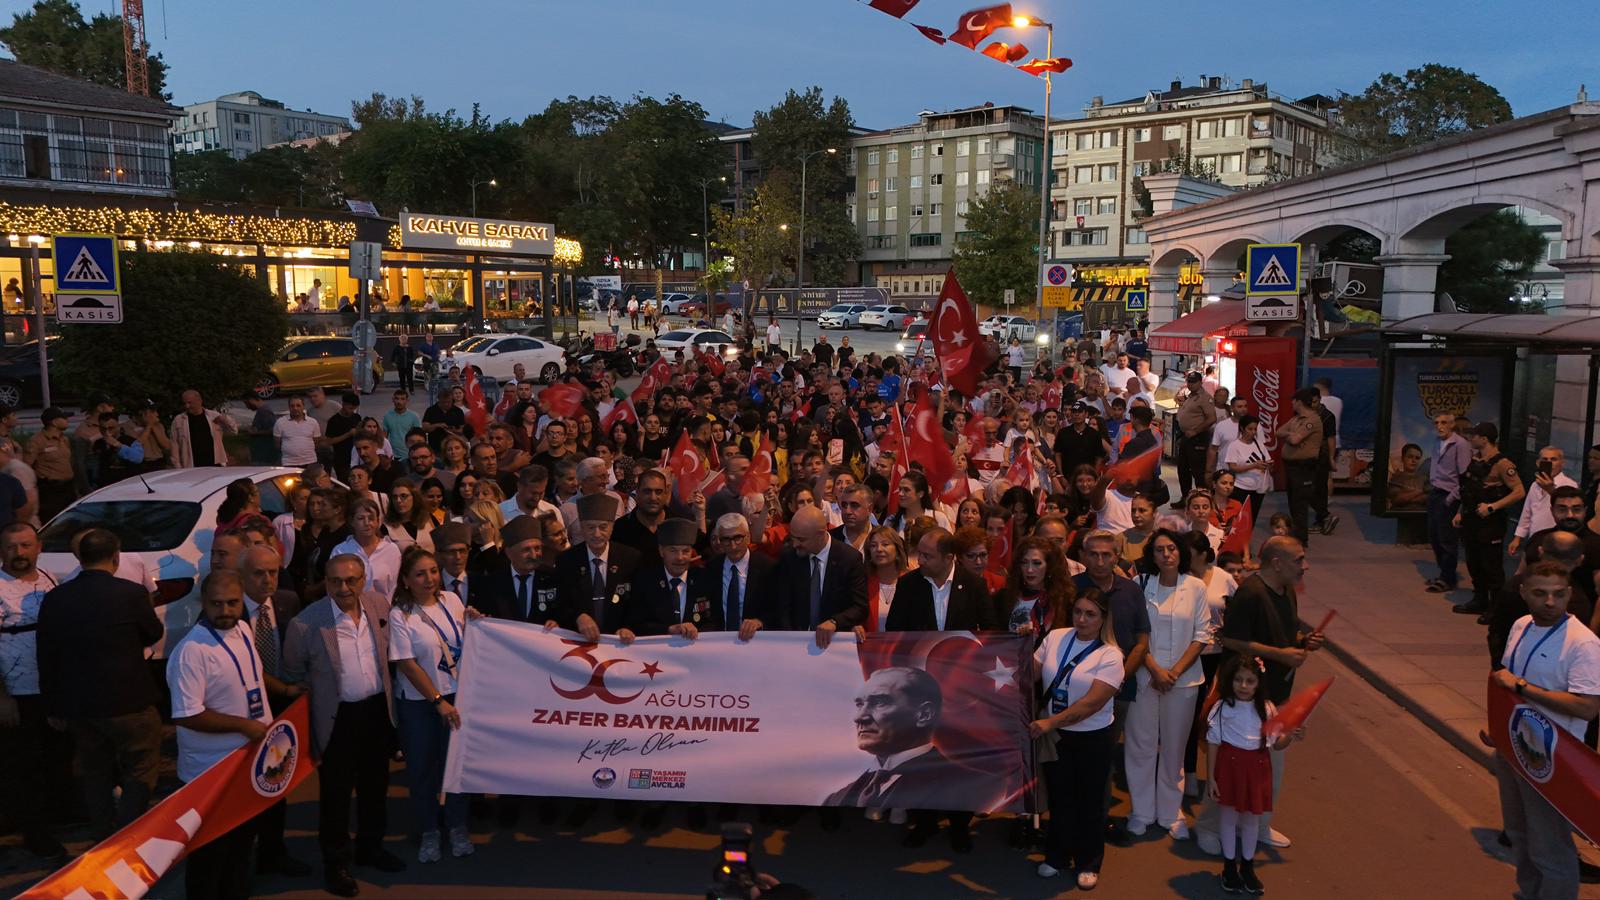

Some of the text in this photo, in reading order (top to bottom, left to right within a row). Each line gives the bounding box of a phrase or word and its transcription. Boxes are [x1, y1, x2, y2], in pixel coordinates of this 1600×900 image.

[408, 216, 548, 241] KAHVE SARAYI
[1105, 275, 1136, 287] SATIR
[65, 310, 114, 319] KASİS
[1253, 308, 1293, 317] KASİS
[645, 690, 750, 709] AĞUSTOS
[532, 709, 760, 733] ZAFER BAYRAMIMIZ
[577, 732, 708, 764] Kutlu Olsun
